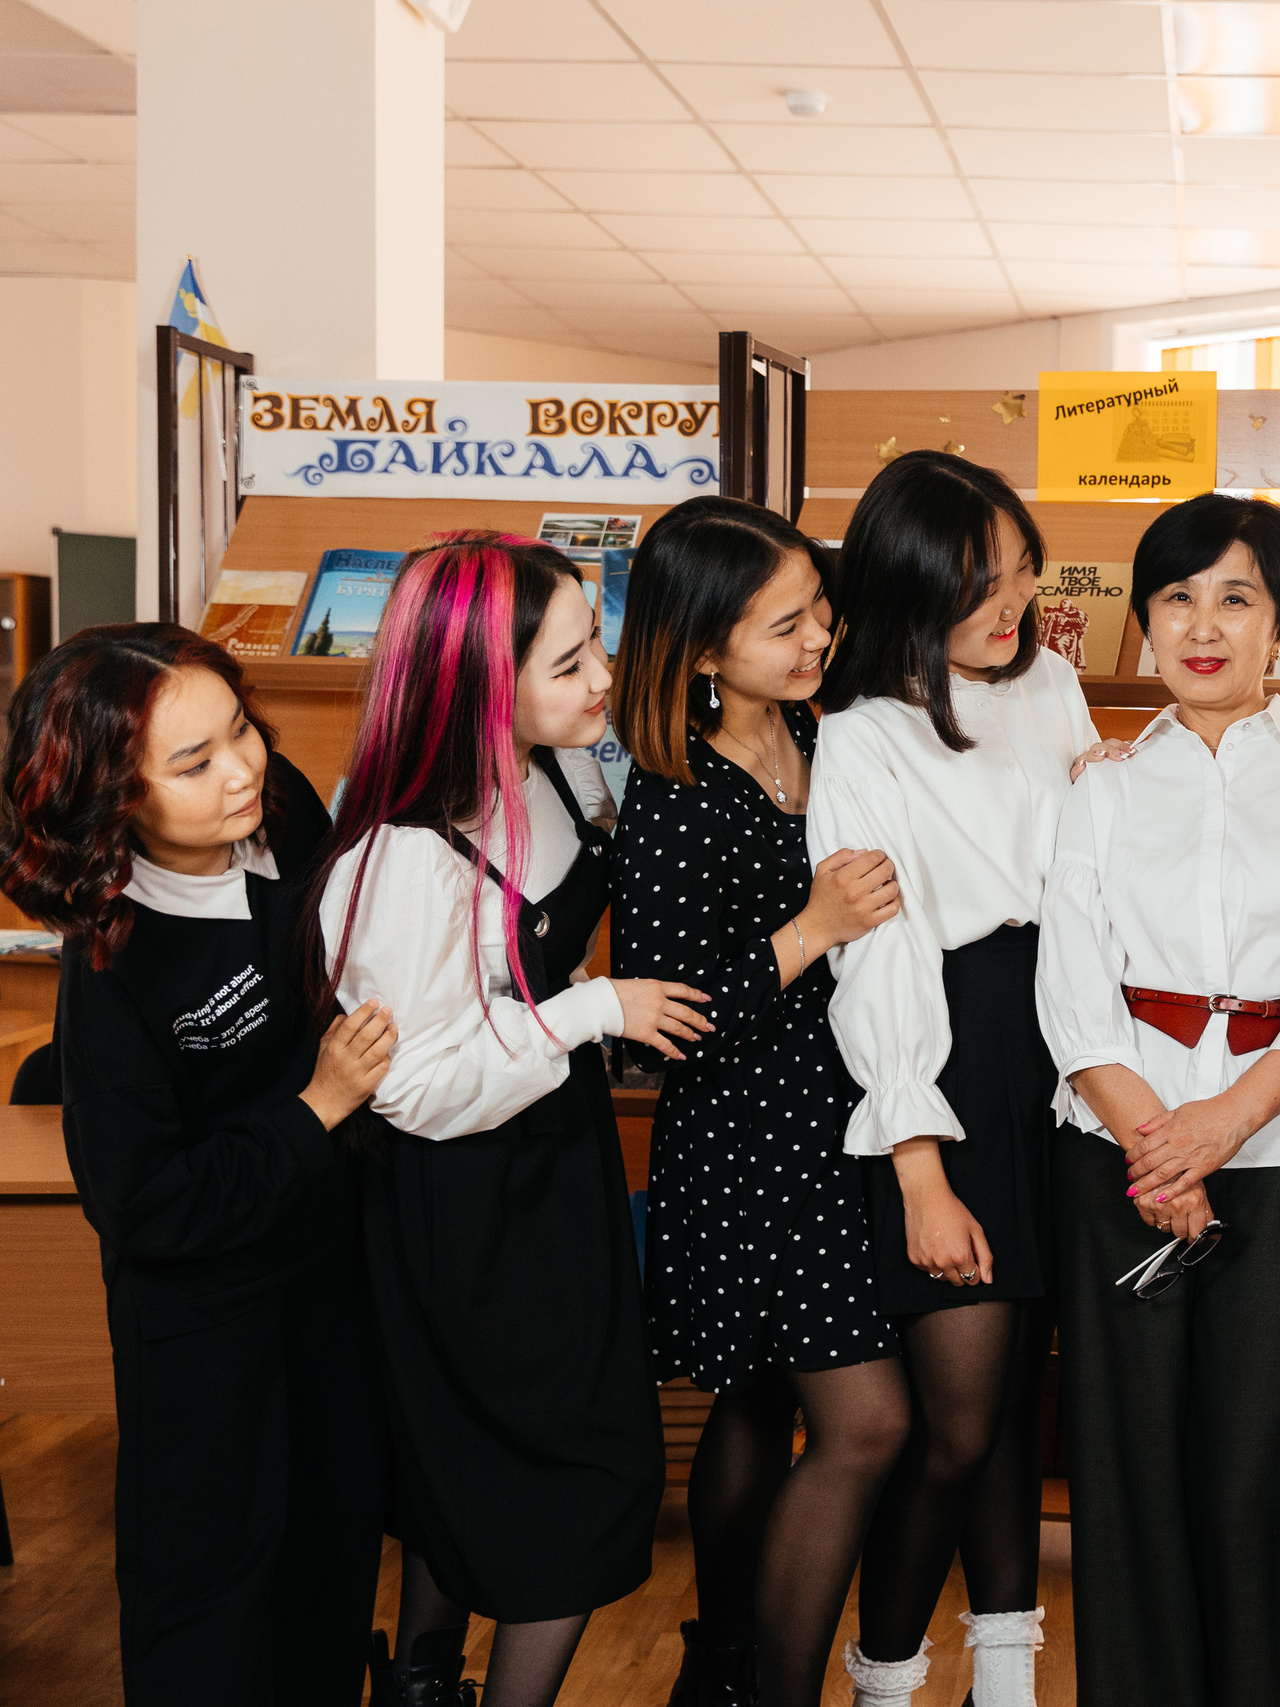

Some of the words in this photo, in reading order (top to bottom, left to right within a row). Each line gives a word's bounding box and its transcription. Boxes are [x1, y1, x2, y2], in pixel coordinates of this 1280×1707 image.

[1054, 378, 1179, 420] Литературный
[250, 391, 439, 434] ЗЕМЛЯ
[525, 397, 720, 438] ВОКРУ
[316, 415, 670, 481] БАЙКАЛА
[1078, 474, 1171, 489] календарь
[1059, 576, 1102, 587] ТВОЕ
[1060, 565, 1097, 577] ИМЯ
[336, 584, 391, 597] БУРЯТ
[214, 985, 232, 1001] not
[229, 964, 255, 989] about
[200, 1013, 216, 1027] It's
[214, 993, 241, 1017] about
[239, 973, 264, 996] effort.
[220, 1026, 236, 1039] это
[235, 1016, 245, 1027] не
[219, 1037, 237, 1049] это
